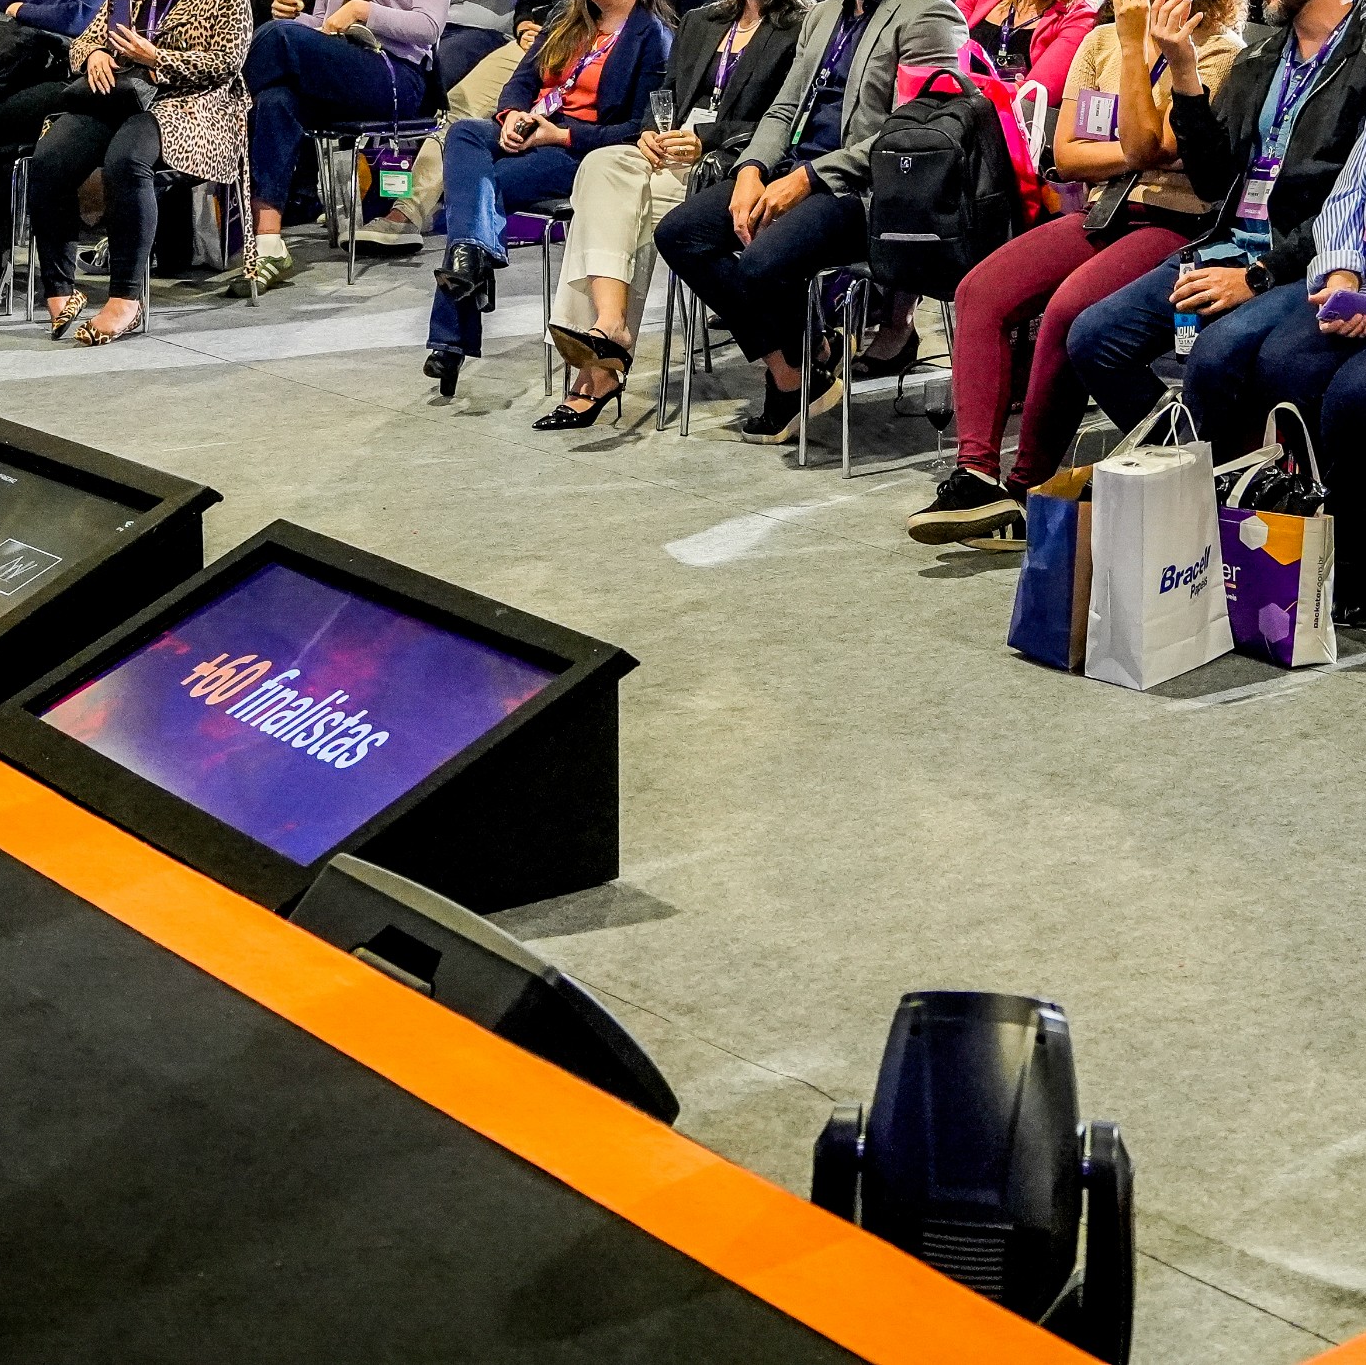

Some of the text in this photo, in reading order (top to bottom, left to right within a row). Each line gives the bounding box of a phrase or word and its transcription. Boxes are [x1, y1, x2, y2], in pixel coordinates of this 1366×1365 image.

[1159, 544, 1212, 594] Bracell
[181, 653, 389, 768] +60 finalistas
